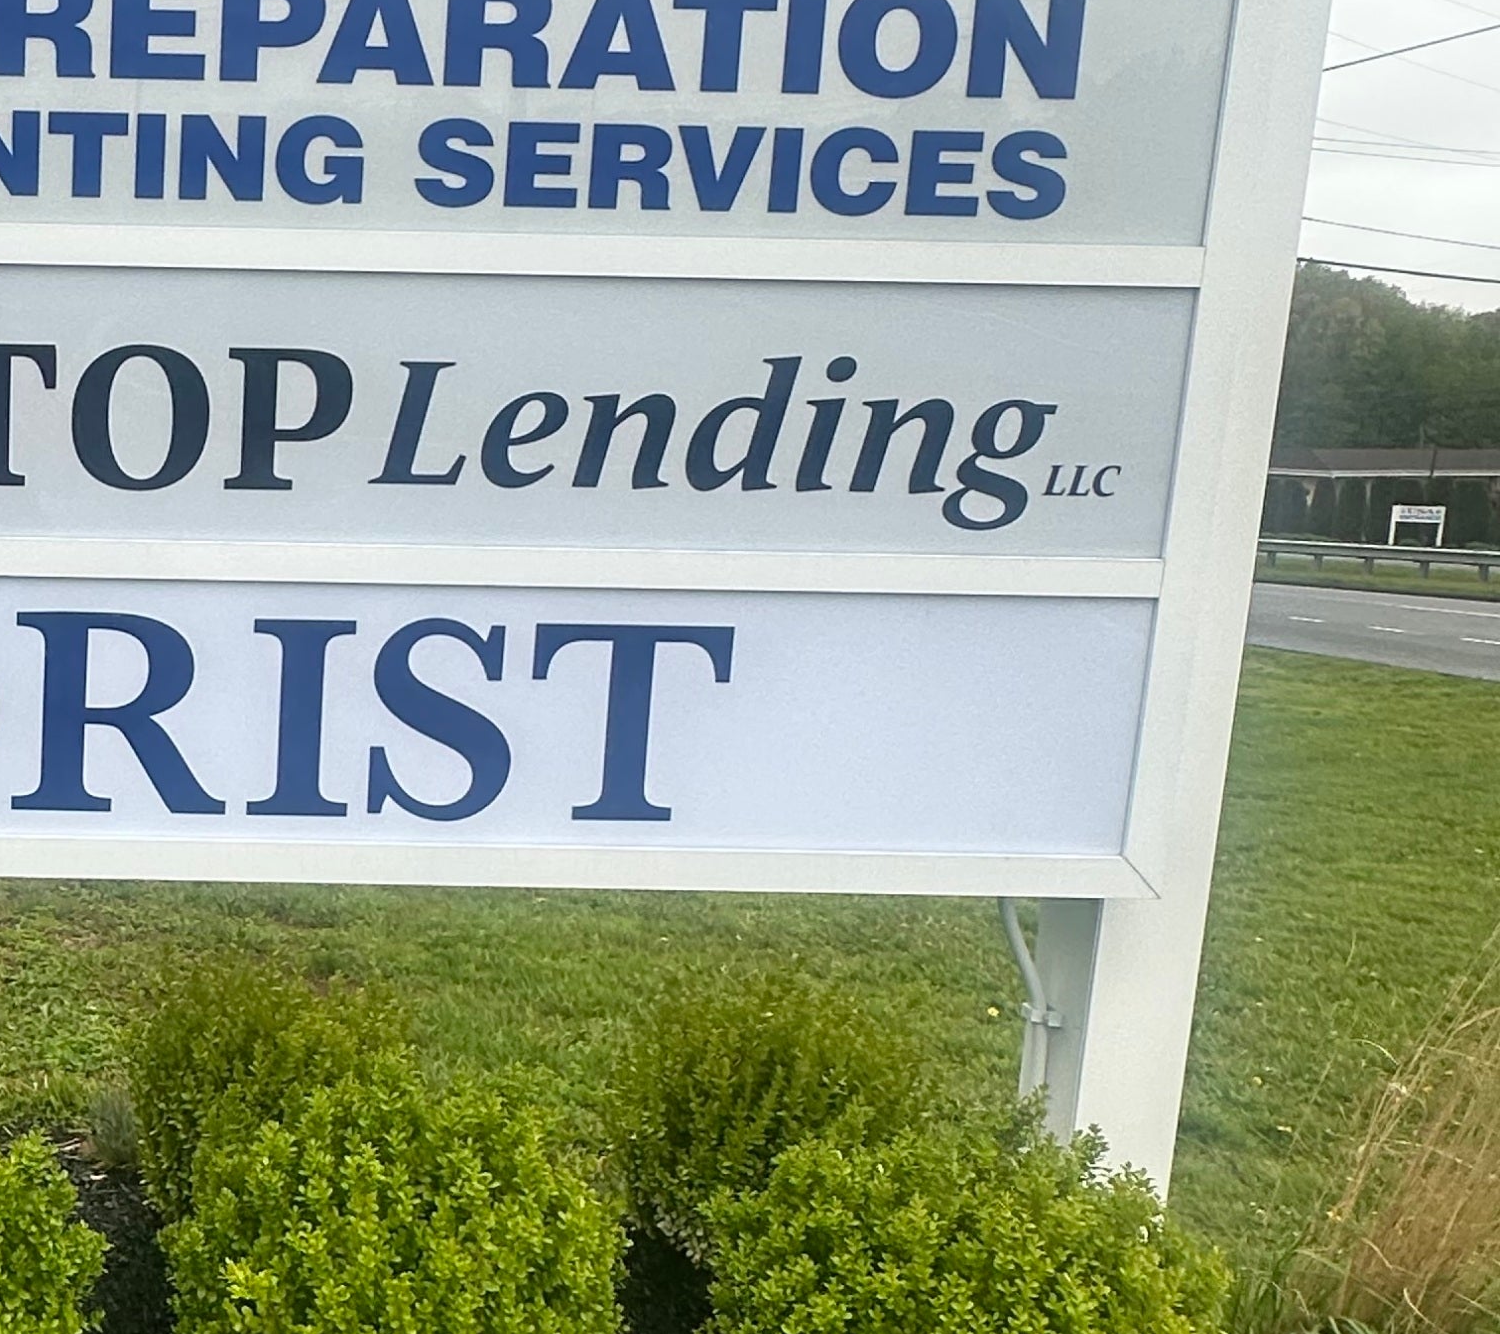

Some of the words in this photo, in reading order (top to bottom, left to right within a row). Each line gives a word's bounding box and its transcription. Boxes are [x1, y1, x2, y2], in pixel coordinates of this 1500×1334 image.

[414, 118, 1067, 220] SERVICES
[368, 356, 1057, 530] Lending
[1042, 465, 1121, 497] LLC
